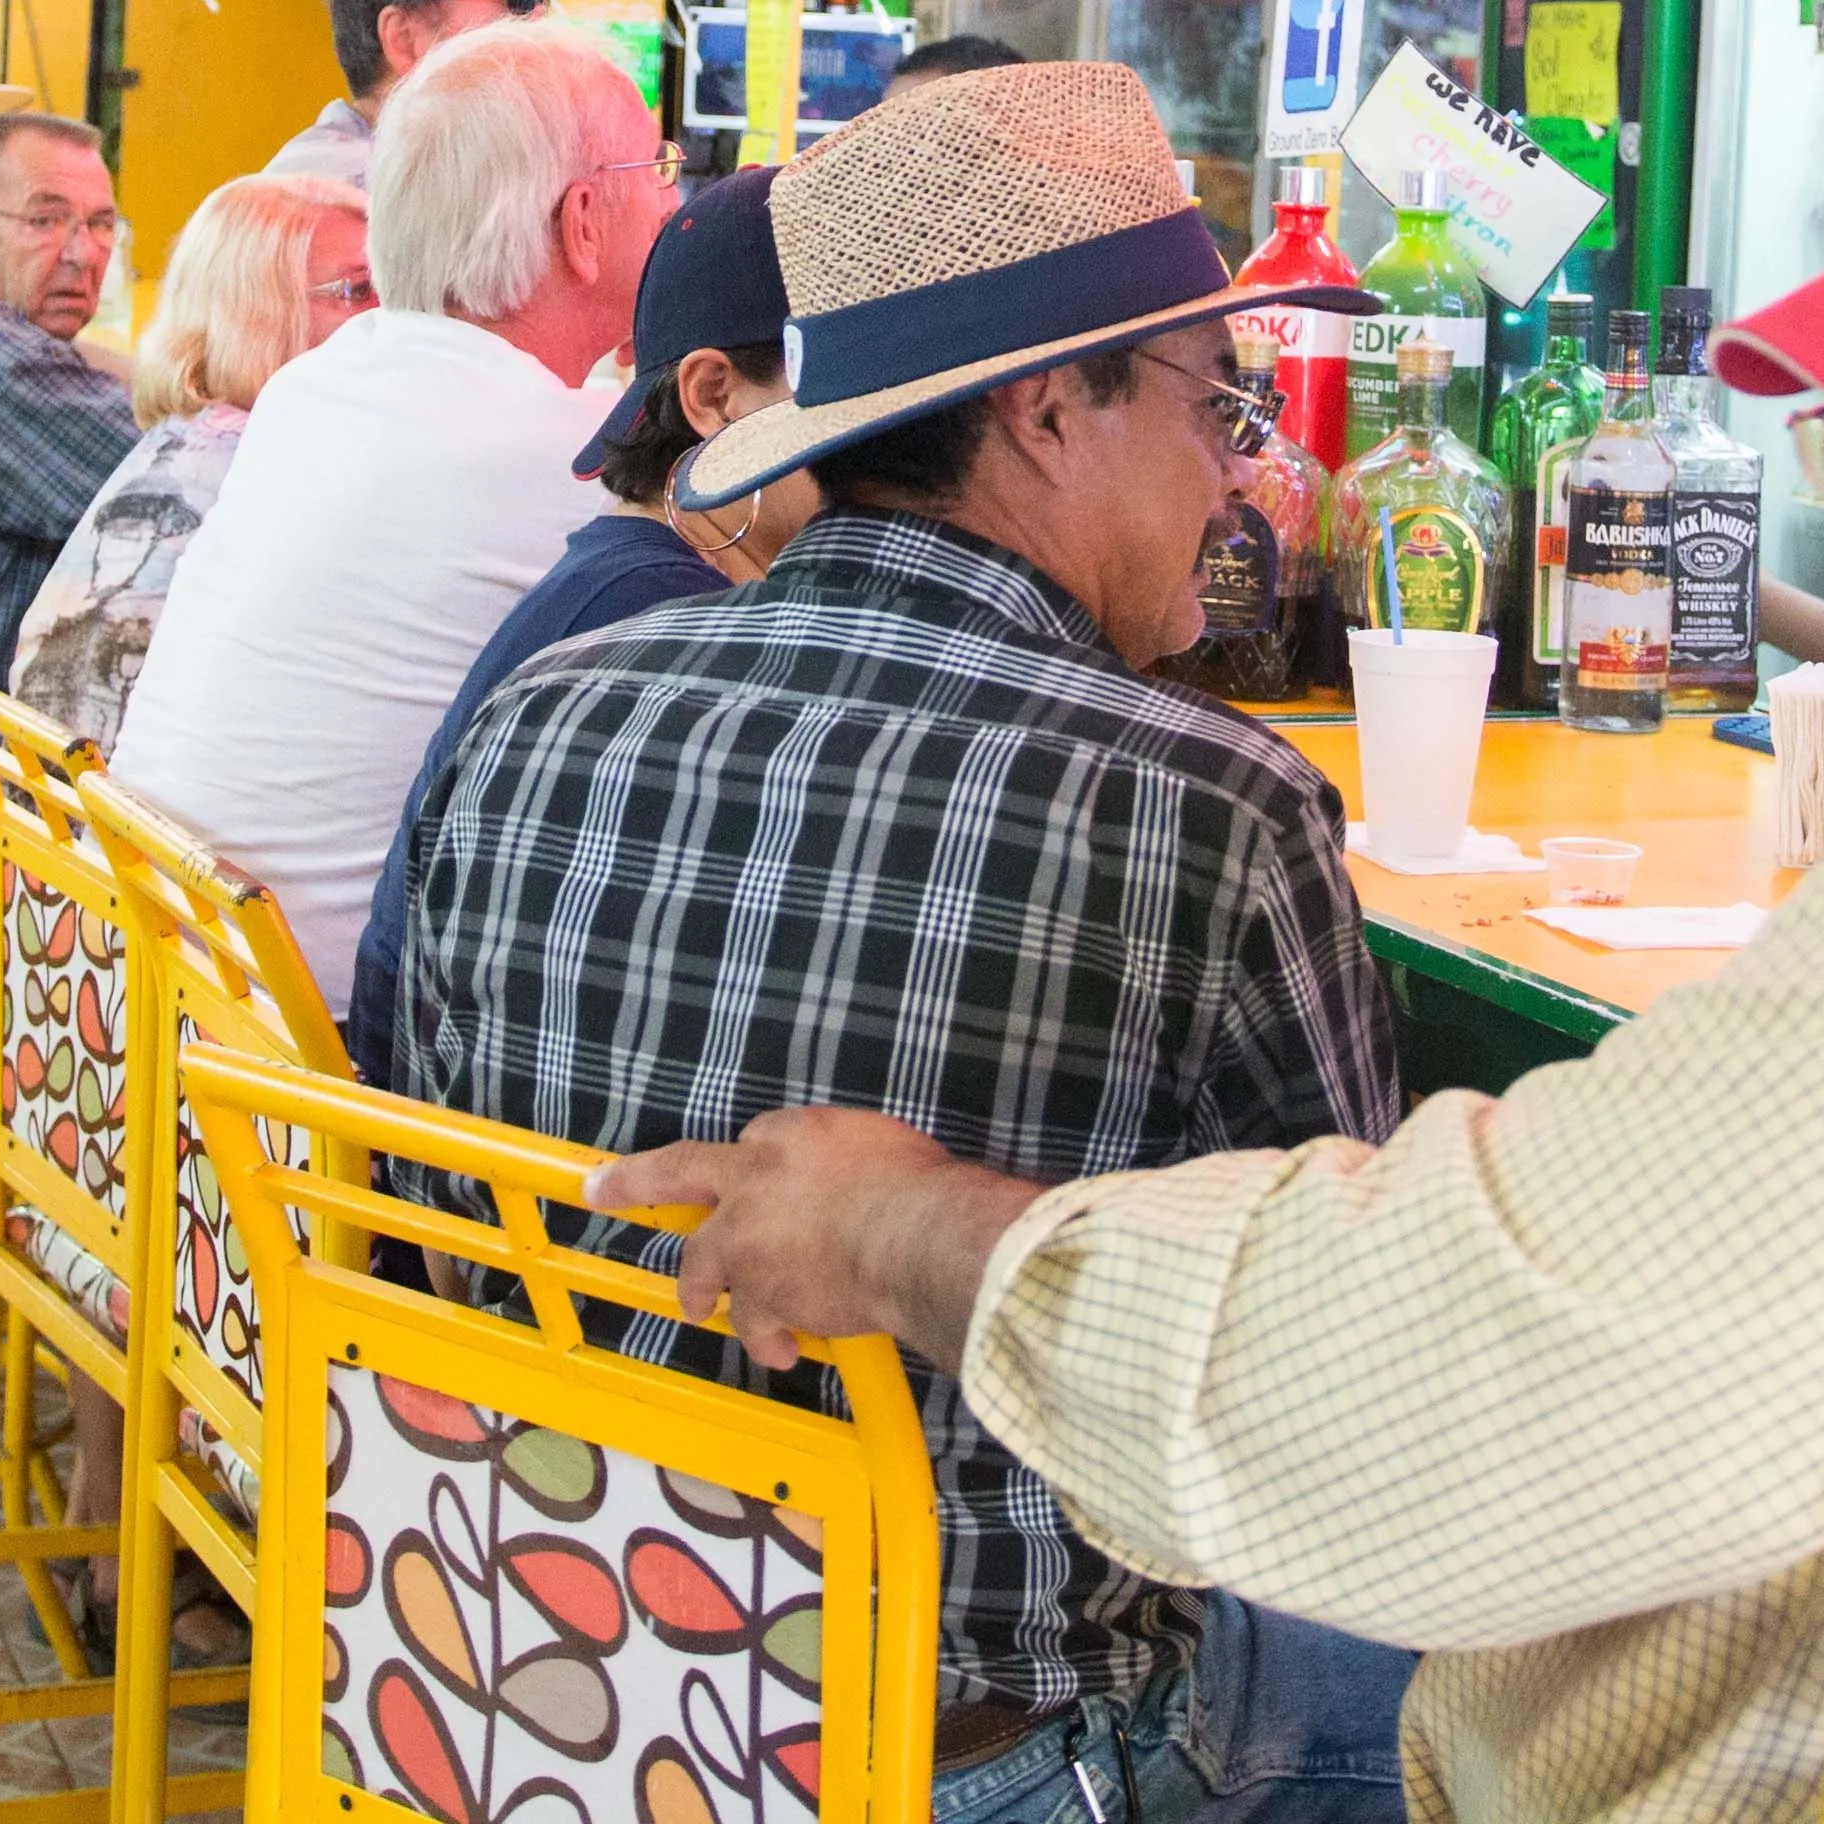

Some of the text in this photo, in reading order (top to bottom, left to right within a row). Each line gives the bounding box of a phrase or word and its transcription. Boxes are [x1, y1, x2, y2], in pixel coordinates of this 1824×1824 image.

[1425, 71, 1470, 113] we
[1473, 105, 1542, 169] have
[1445, 193, 1513, 258] itron
[1353, 321, 1428, 355] EDK
[1584, 522, 1673, 547] BABUSHKA
[1675, 506, 1758, 549] ACK DANIEL'S
[1610, 548, 1655, 562] VODKA
[1677, 576, 1741, 595] Tennessee
[1677, 600, 1739, 613] WHISKEY
